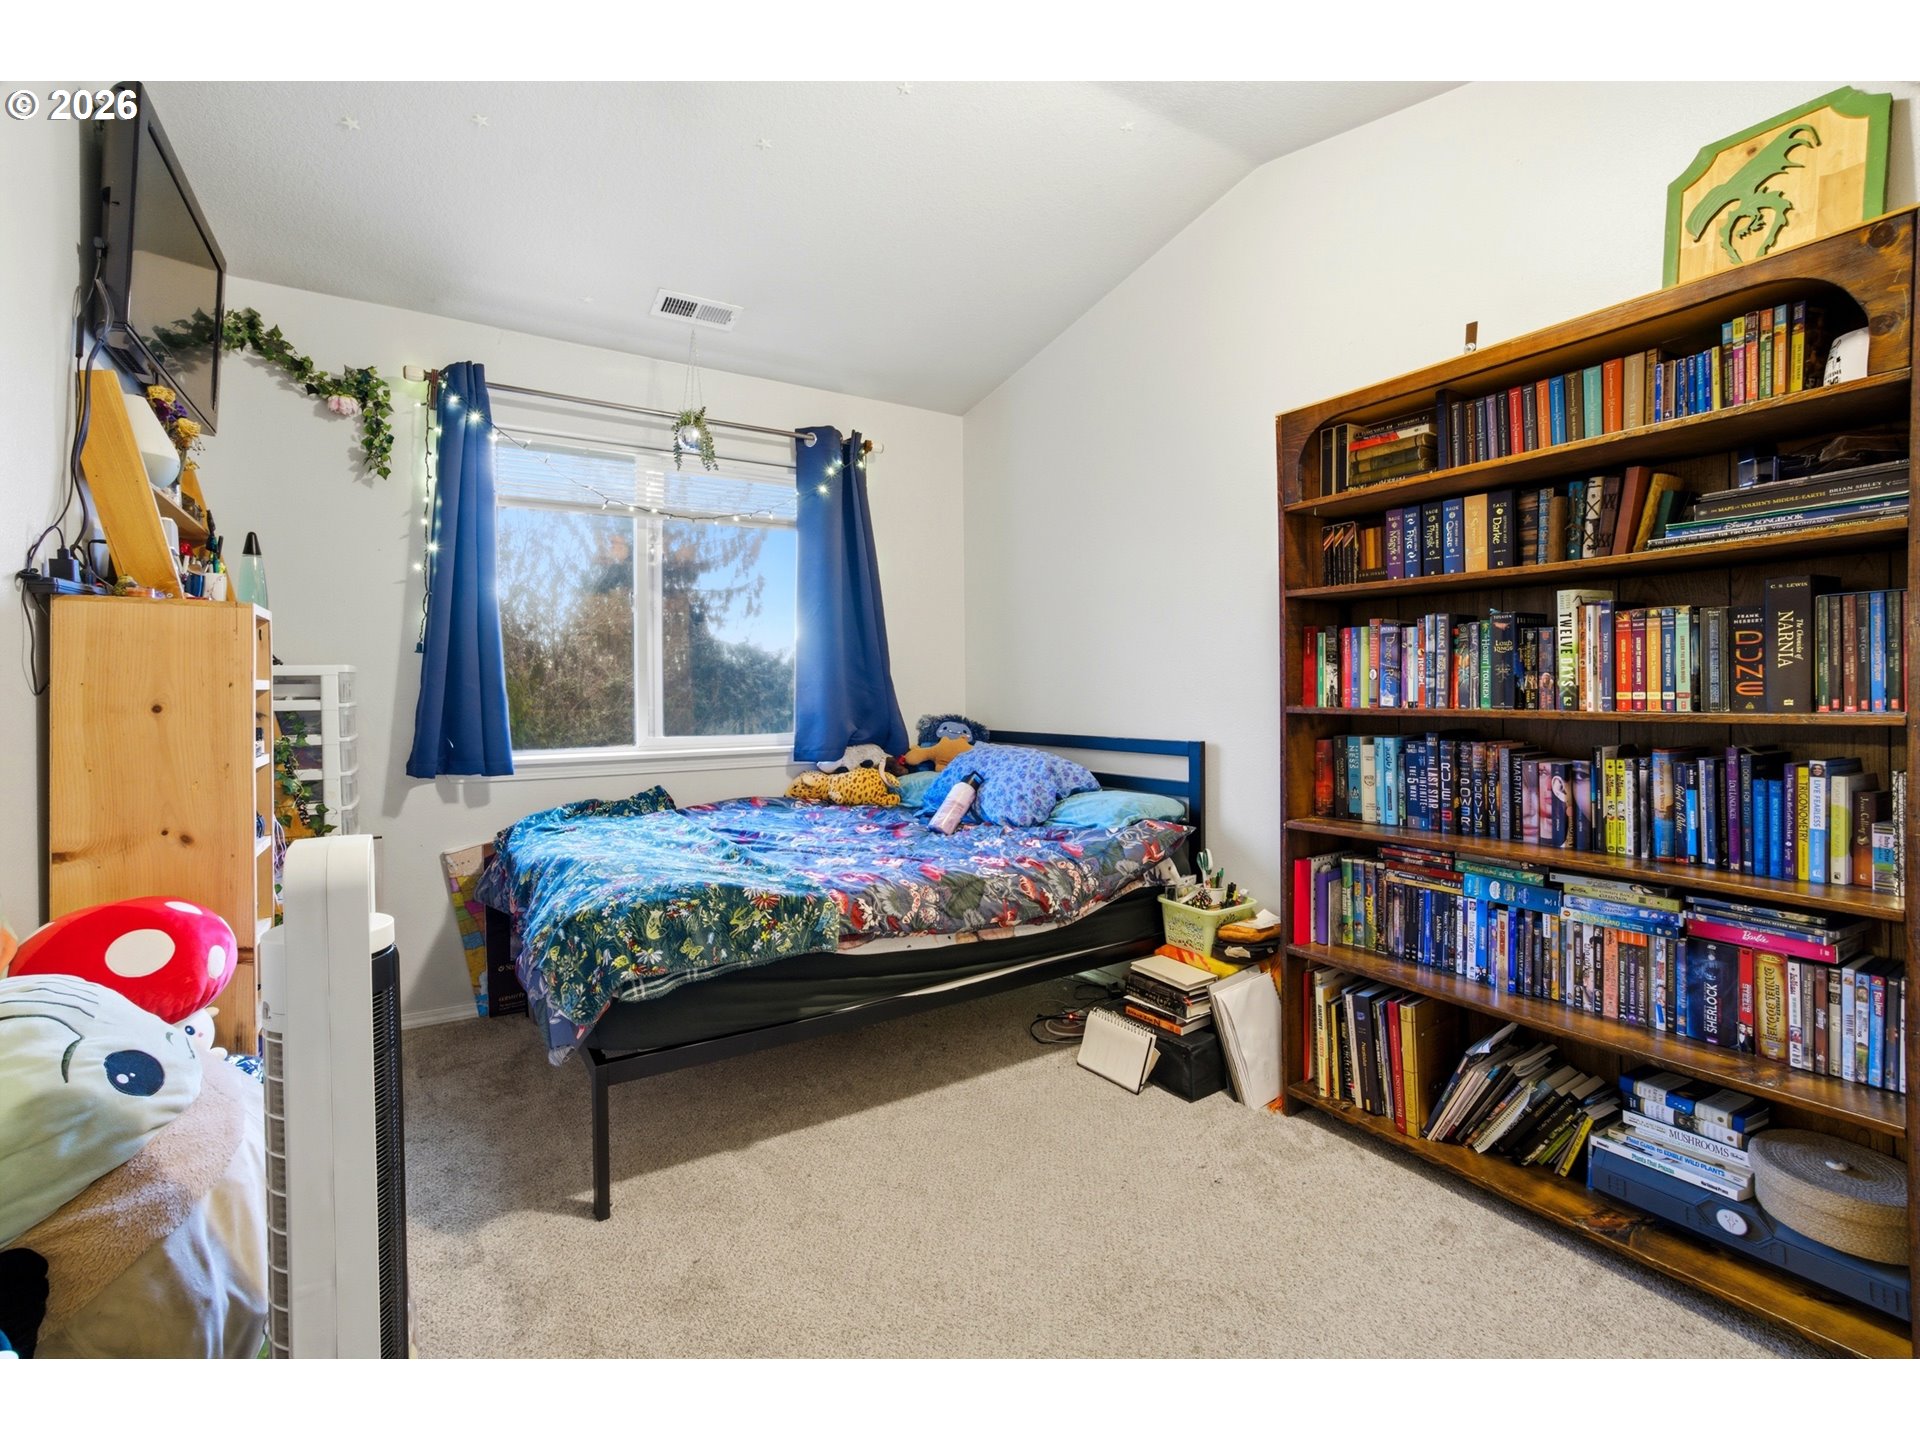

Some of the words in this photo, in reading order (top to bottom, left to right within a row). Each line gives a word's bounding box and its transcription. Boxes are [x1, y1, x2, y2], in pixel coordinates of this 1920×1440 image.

[1828, 486, 1854, 494] BRIAN
[1855, 481, 1882, 490] SIBLEY
[1741, 500, 1771, 509] TOLKIEN'S
[1772, 491, 1826, 504] MIDDLE-EARTH
[1493, 517, 1502, 544] Darke
[1754, 513, 1804, 526] SONGBOOK
[1388, 531, 1397, 555] Magyk
[1405, 530, 1413, 549] Flyte
[1424, 525, 1435, 548] Physik
[1446, 521, 1454, 548] Queste
[1560, 612, 1573, 654] TWELVE
[1796, 618, 1804, 628] The
[1385, 634, 1396, 665] Dragon
[1778, 610, 1794, 668] NARNIA
[1561, 658, 1575, 687] DAYS
[1735, 630, 1763, 696] DUNE
[1384, 669, 1394, 691] Rider
[1428, 768, 1438, 786] LAST
[1440, 762, 1450, 800] RULE
[1513, 761, 1521, 803] MARTIAN
[1409, 785, 1417, 801] WAVE
[1419, 777, 1427, 806] INFINITE
[1428, 789, 1438, 809] STAR
[1676, 784, 1684, 800] Girl
[1676, 802, 1683, 811] in
[1798, 782, 1808, 842] TRIGONOMETRY
[1676, 812, 1686, 833] Blue
[1859, 813, 1869, 834] Calling
[1365, 896, 1374, 924] TOTORO
[1730, 905, 1754, 913] epic
[1742, 930, 1768, 943] Barbie
[1764, 967, 1775, 1001] DANIEL
[1707, 983, 1717, 1034] SHERLOCK
[1766, 1002, 1776, 1034] BOONE
[1669, 1128, 1730, 1158] MUSHROOMS
[1684, 1157, 1700, 1168] WILD
[1701, 1162, 1725, 1177] PLANTS
